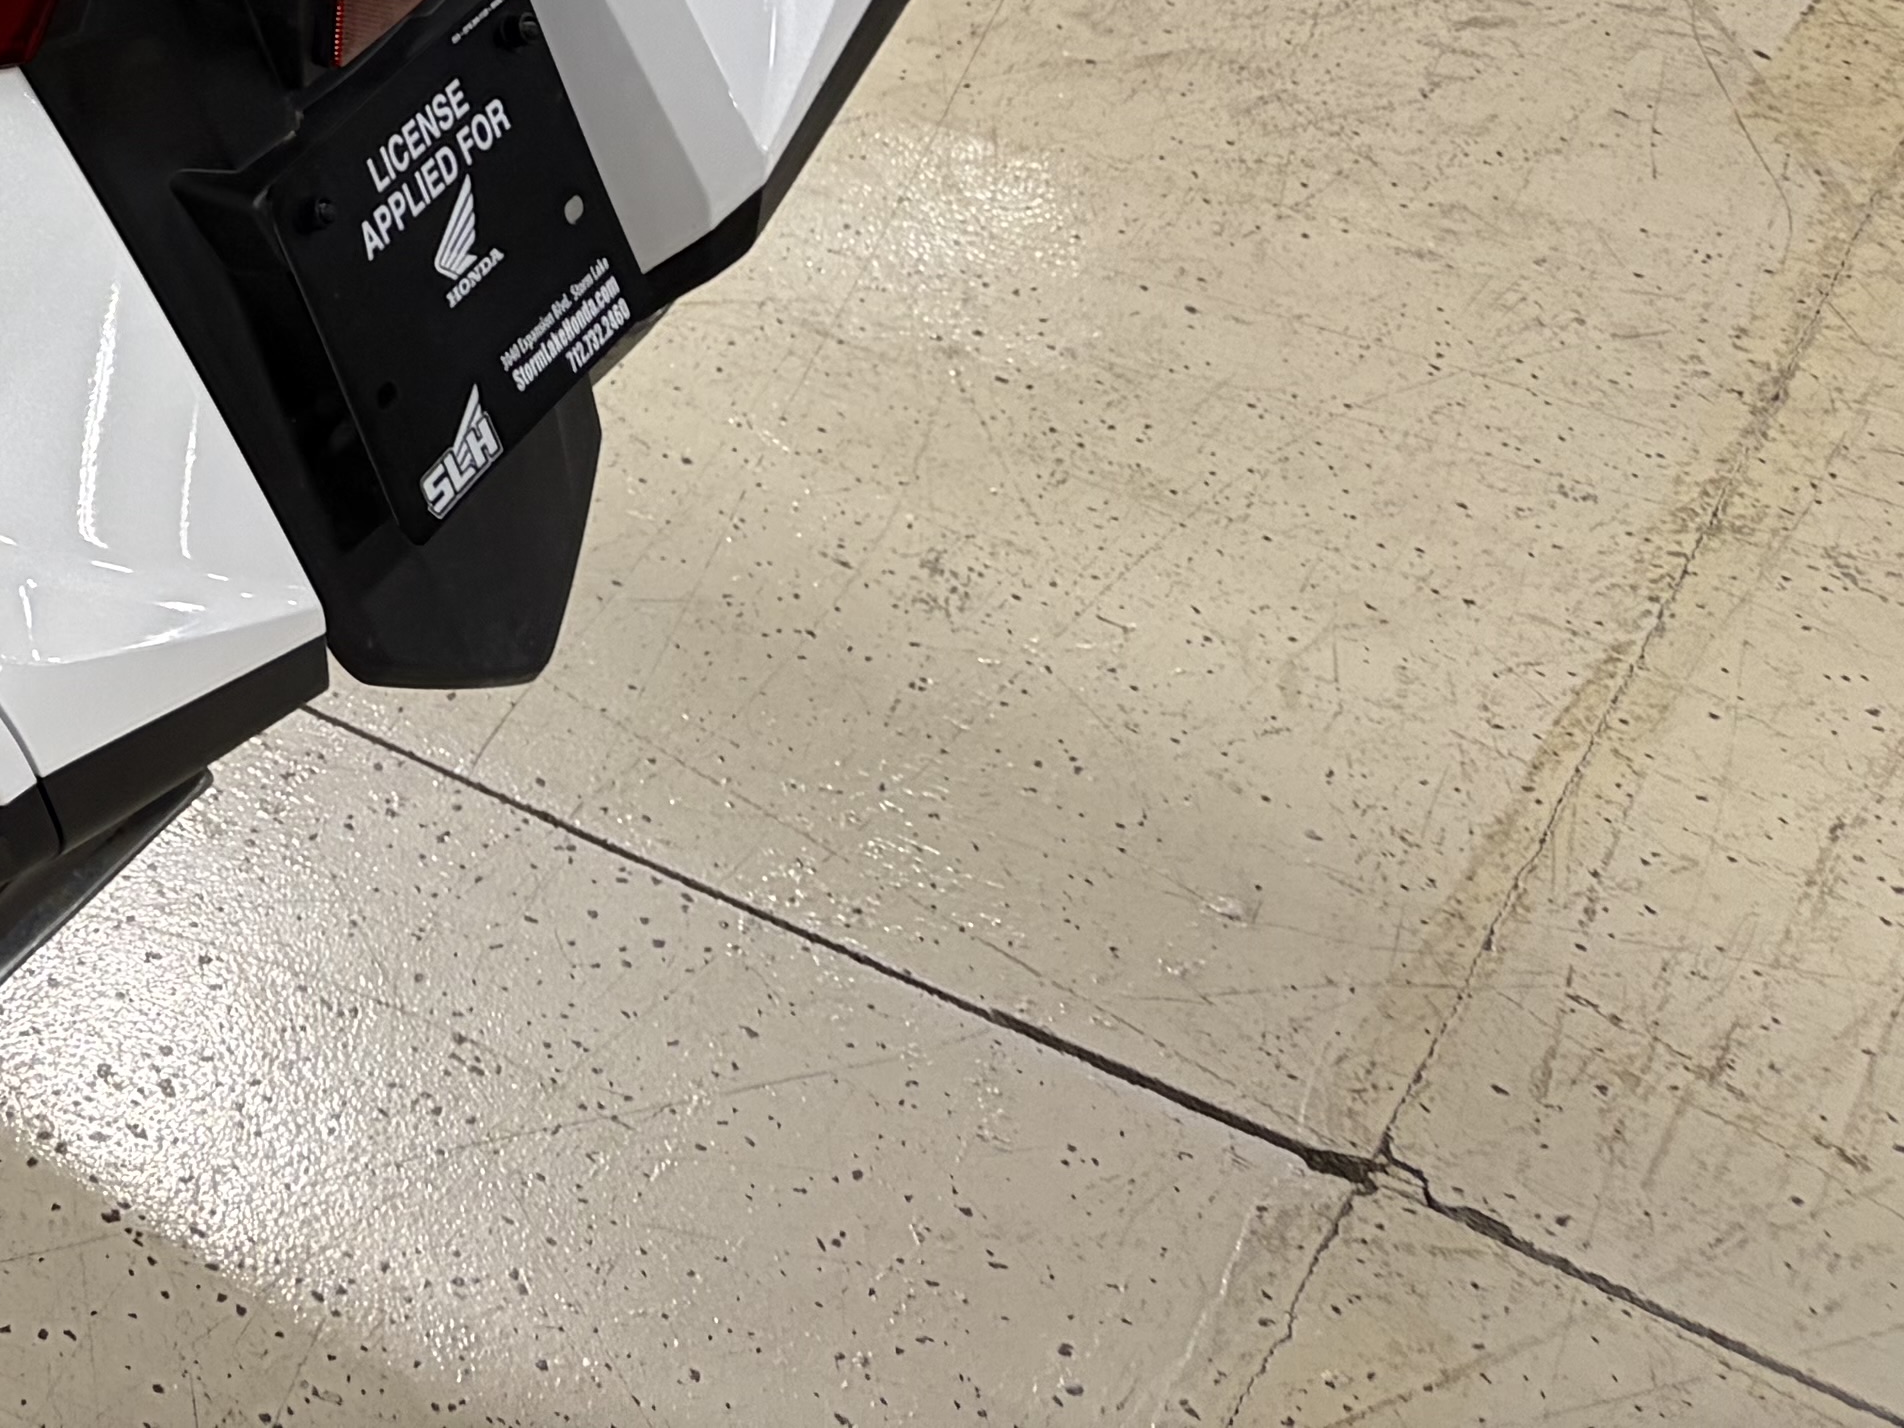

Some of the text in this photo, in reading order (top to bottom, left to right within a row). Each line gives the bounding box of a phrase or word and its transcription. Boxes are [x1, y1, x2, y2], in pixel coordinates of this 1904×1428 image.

[361, 98, 512, 261] APPLIED FOR
[366, 78, 470, 193] LICENSE
[445, 247, 505, 309] HONDA
[517, 311, 556, 354] Expansion
[570, 273, 594, 301] Storm
[590, 257, 610, 281] Lake
[512, 275, 620, 392] StormLakeHonda.com
[565, 297, 631, 374] 712.732.2460
[421, 413, 501, 517] SLH
